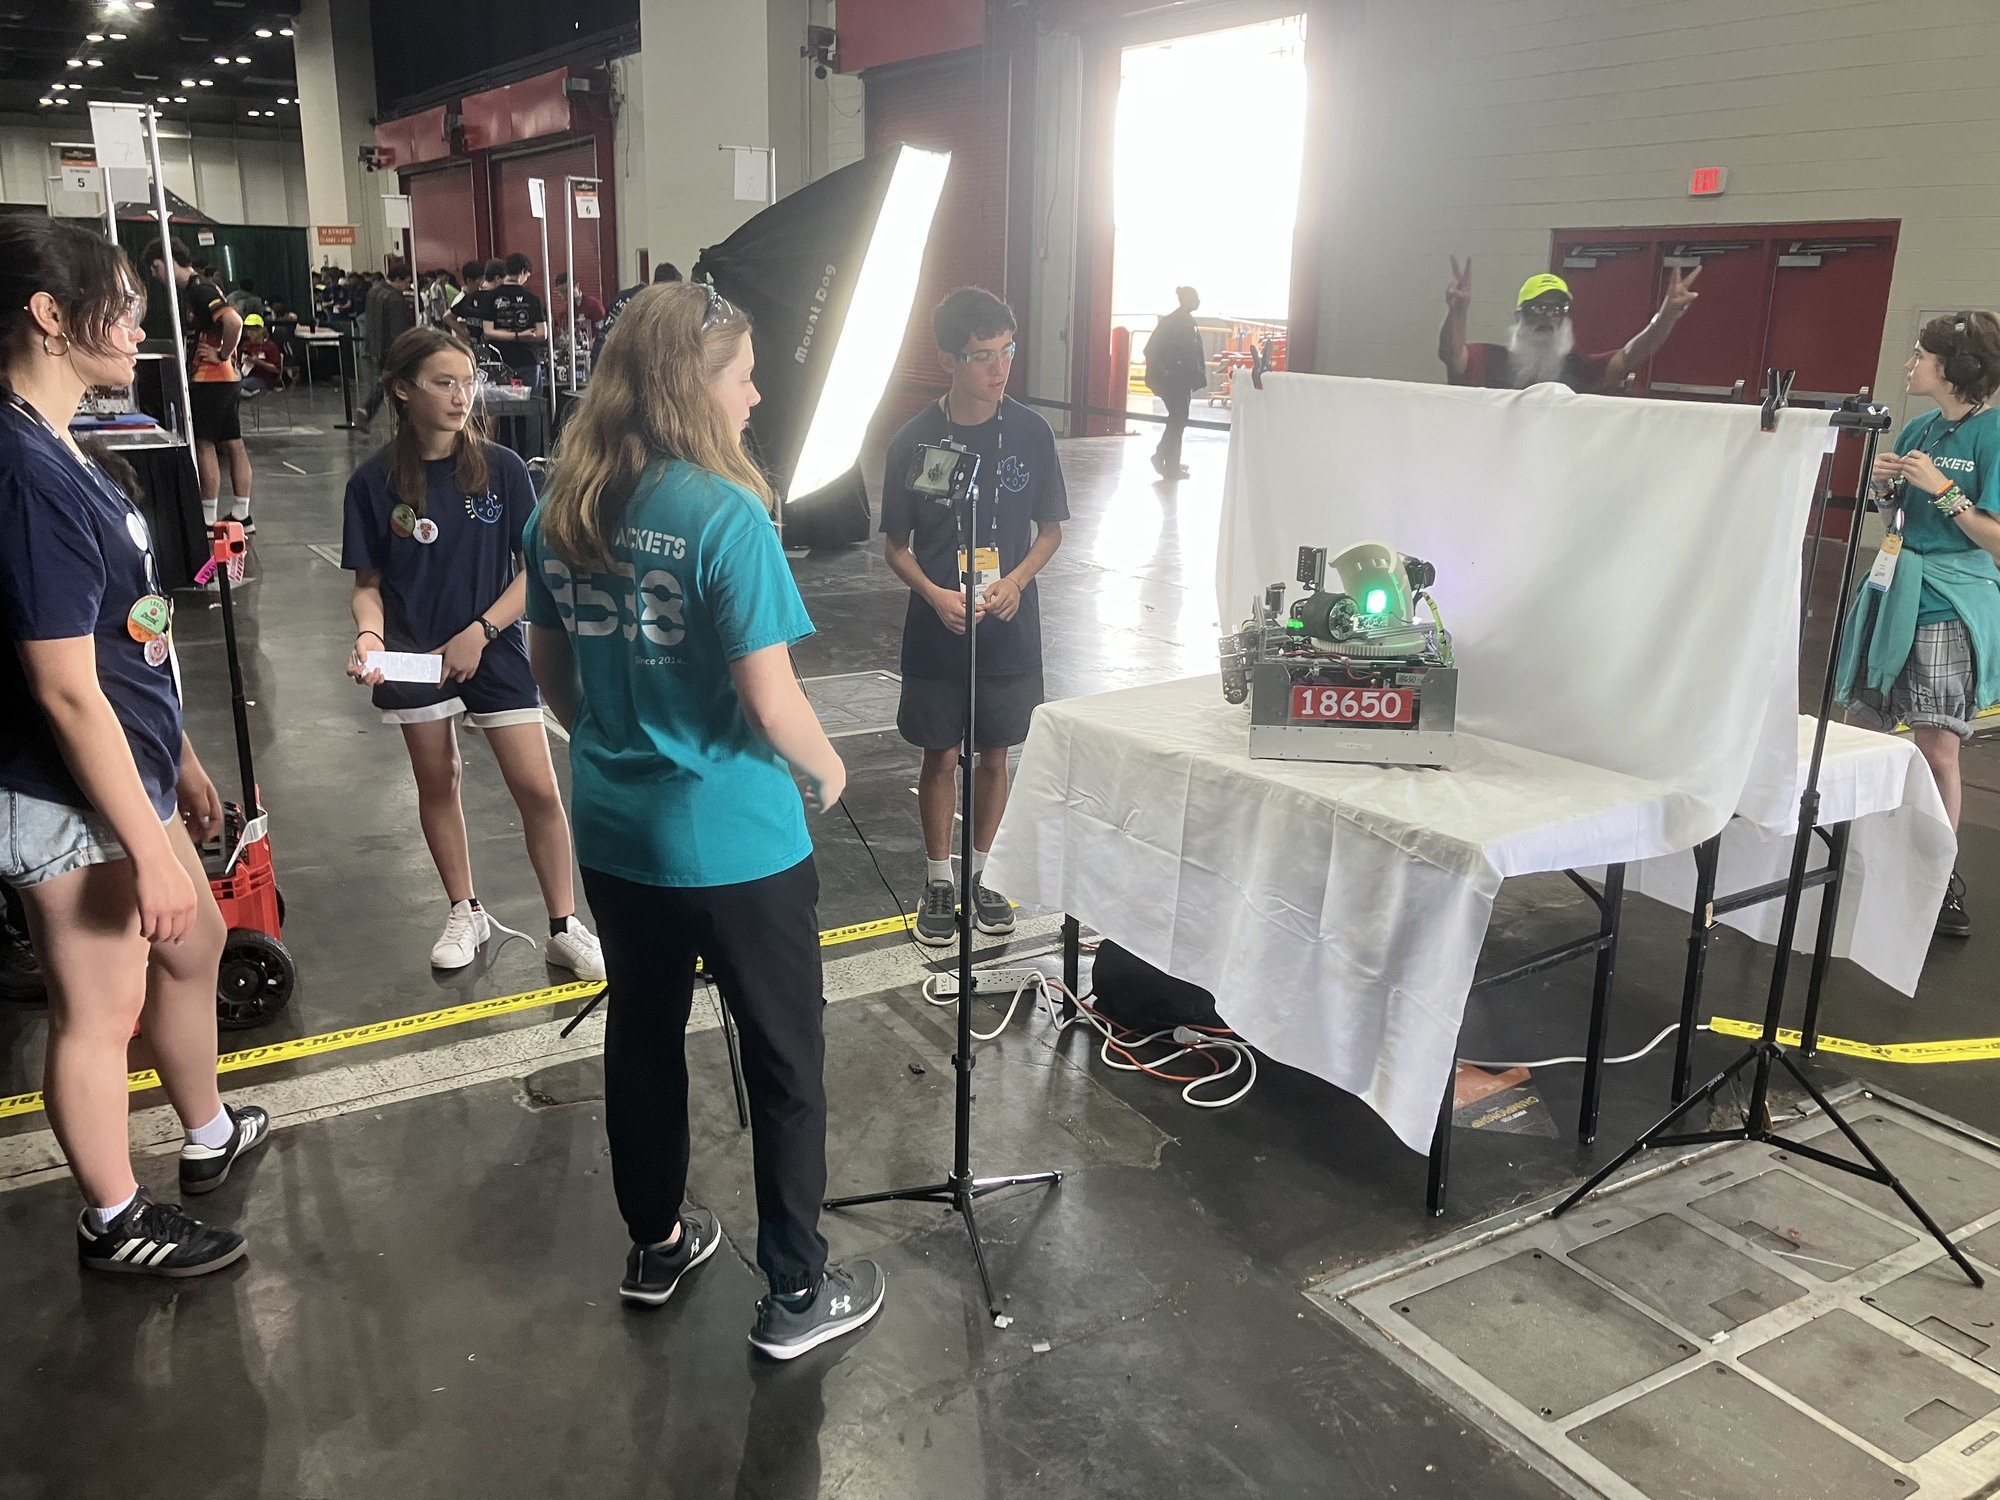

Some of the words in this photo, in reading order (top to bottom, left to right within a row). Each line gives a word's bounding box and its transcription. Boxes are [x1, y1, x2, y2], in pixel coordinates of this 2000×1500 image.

[77, 177, 86, 188] 5
[1692, 168, 1720, 193] EXIT
[585, 205, 592, 215] 6
[794, 306, 822, 364] Mount
[814, 264, 837, 302] Dog
[613, 527, 687, 560] ACKETS
[1301, 689, 1402, 719] 18650
[1471, 1096, 1540, 1129] CHAMPIONSHIP
